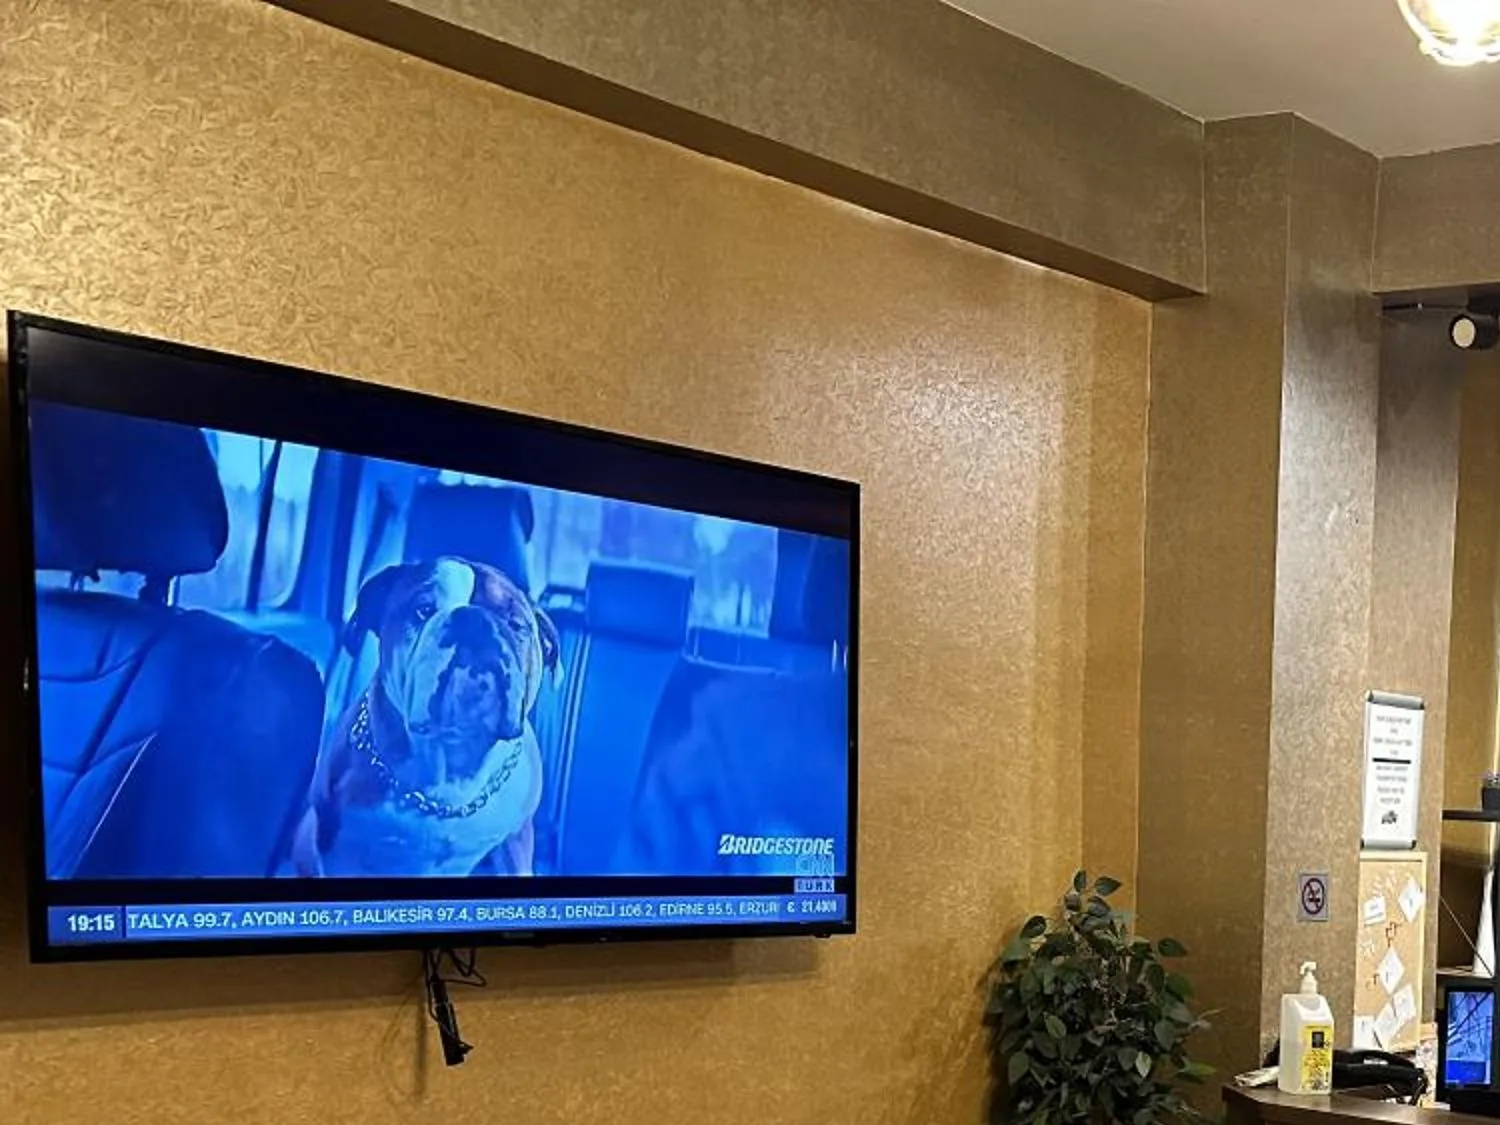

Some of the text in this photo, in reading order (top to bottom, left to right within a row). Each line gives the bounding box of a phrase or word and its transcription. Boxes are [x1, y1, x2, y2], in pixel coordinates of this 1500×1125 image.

[718, 834, 835, 855] BRIDGESTONE
[67, 914, 115, 932] 19:15
[128, 913, 189, 929] TALYA
[193, 912, 237, 928] 99.7,
[241, 911, 296, 926] AYDIN
[301, 909, 348, 926] 106.7,
[437, 907, 473, 923] 97.4,
[476, 906, 525, 921] BURSA
[529, 905, 561, 921] 88.1,
